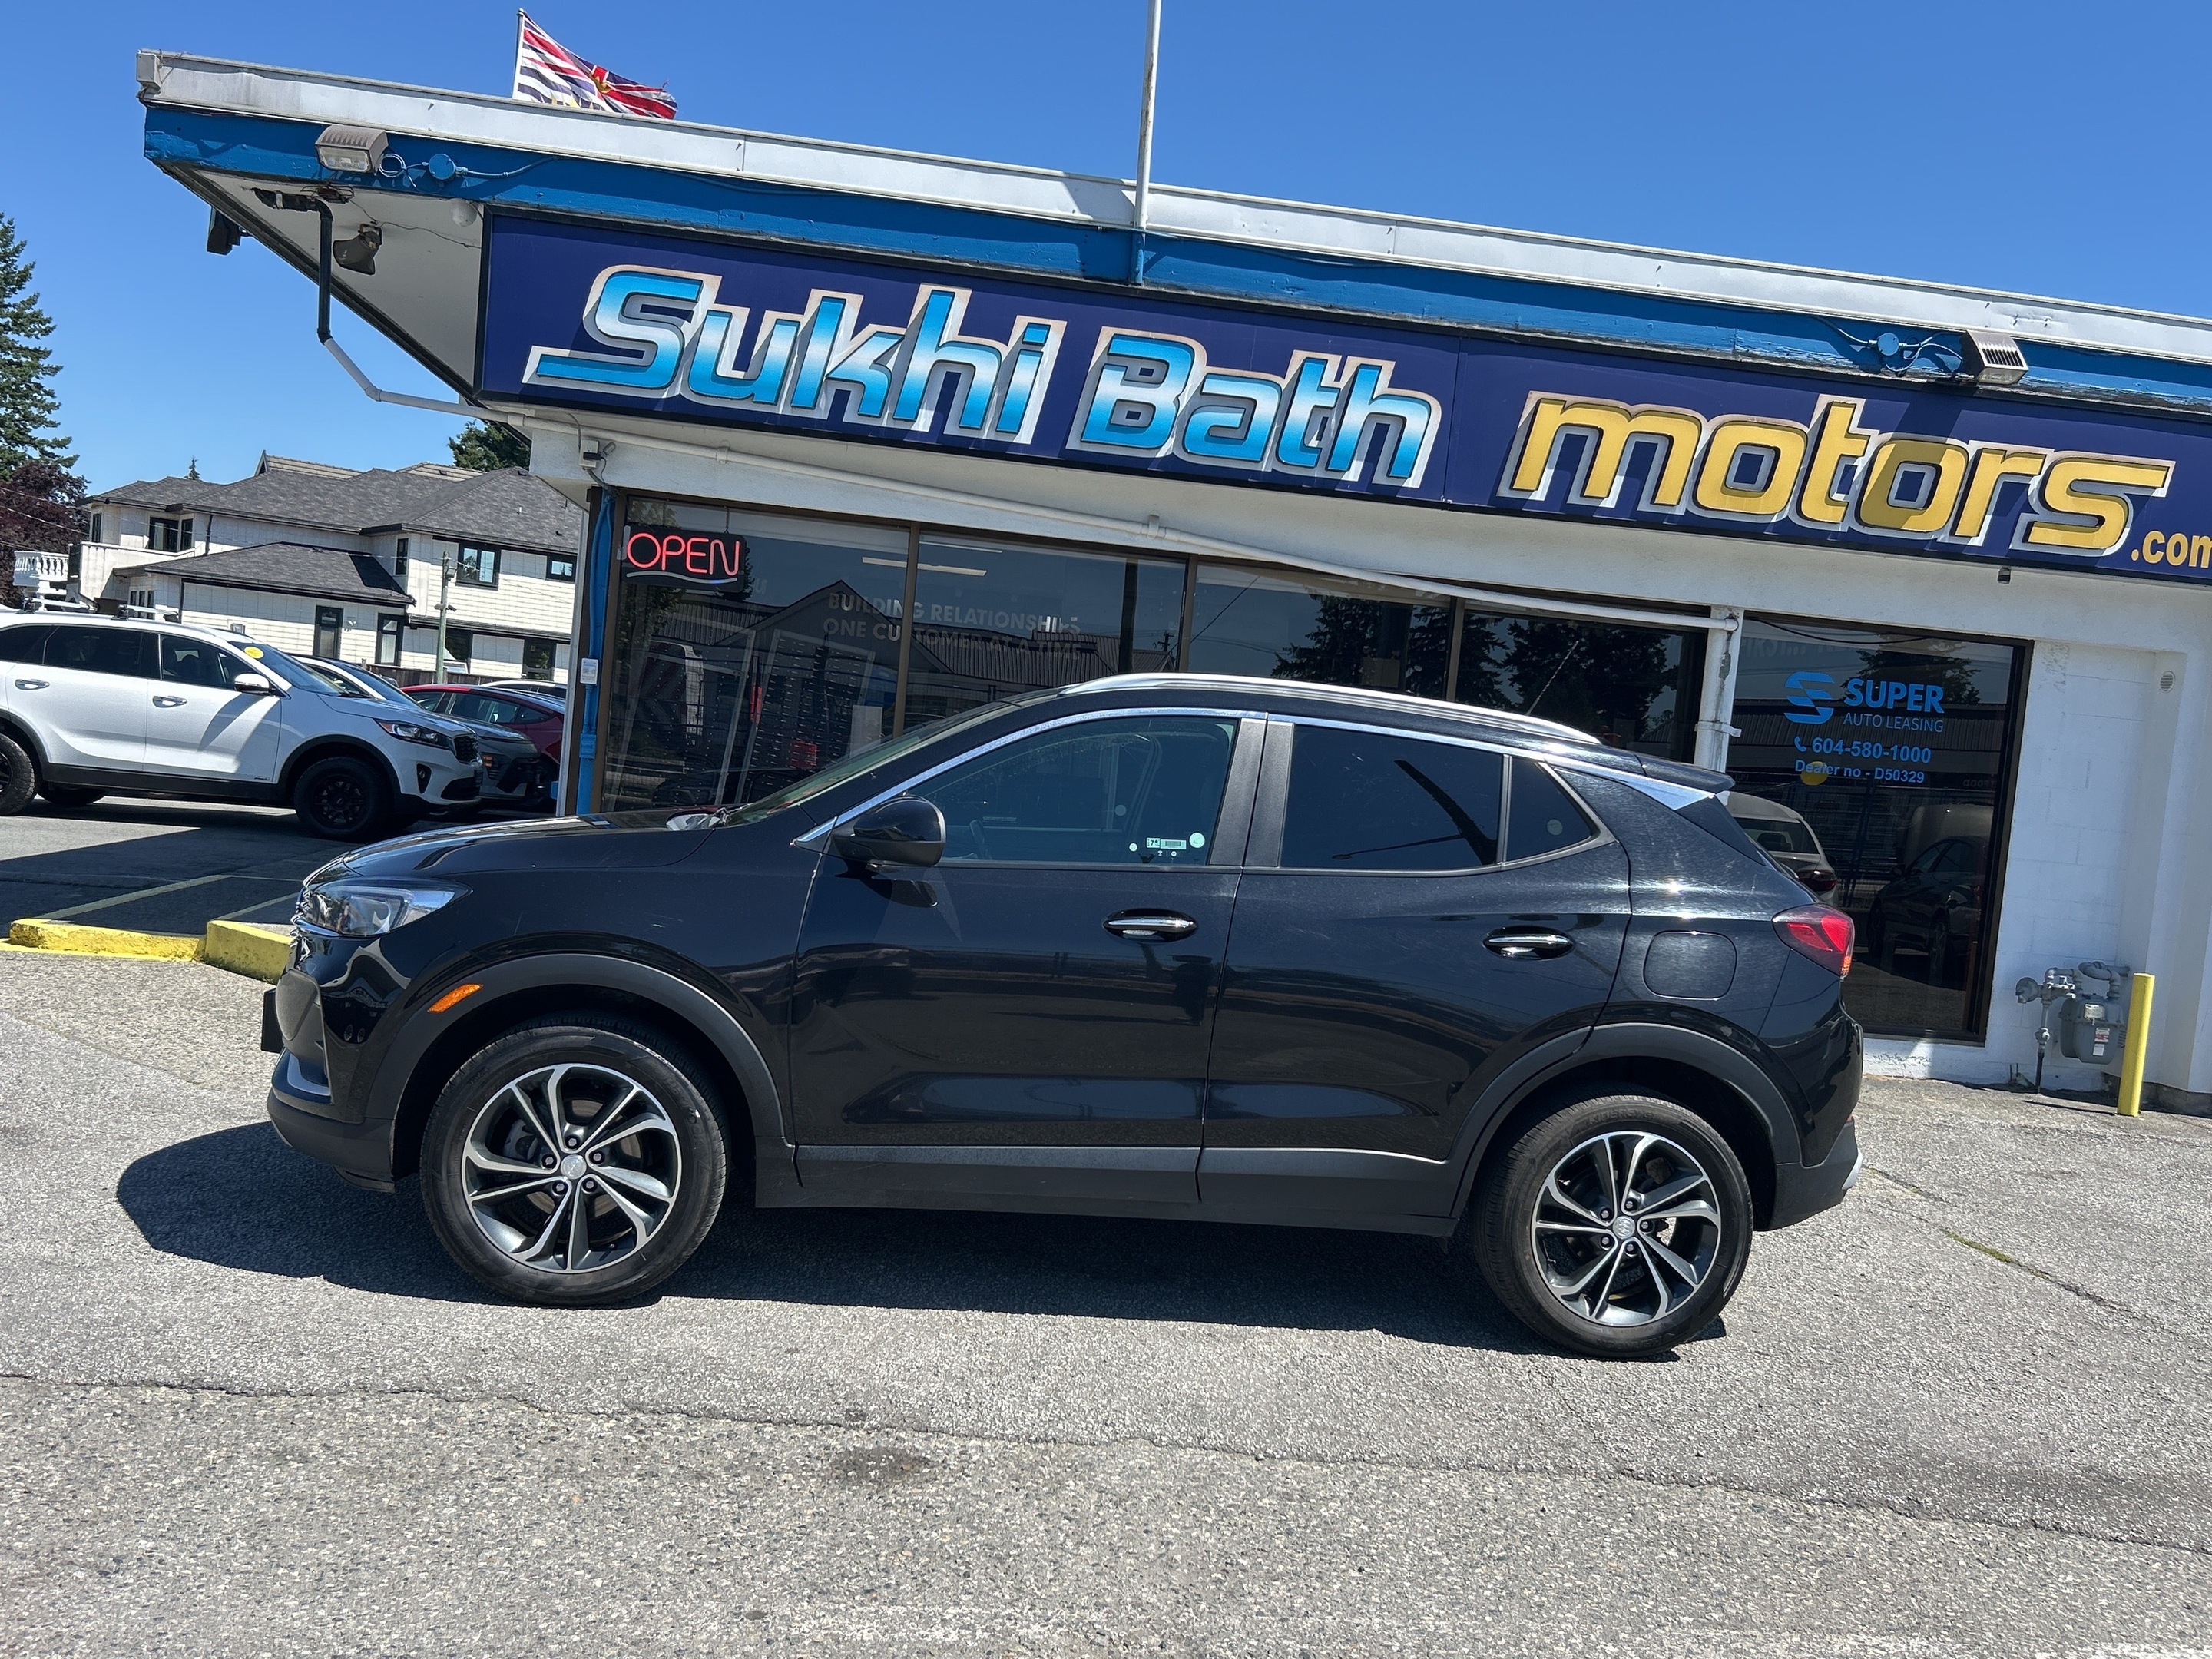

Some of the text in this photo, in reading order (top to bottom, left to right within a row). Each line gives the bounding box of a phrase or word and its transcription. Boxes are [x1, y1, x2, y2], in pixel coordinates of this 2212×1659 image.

[522, 264, 1067, 445] Sukhi
[1066, 326, 1442, 488] Bath
[1495, 390, 2176, 557] motors
[625, 531, 740, 577] OPEN
[823, 618, 867, 638] ONE
[1844, 677, 1945, 714] SUPER
[1843, 712, 1944, 733] AUTO LEASING
[1811, 737, 1932, 763] 604-580-1000
[1795, 759, 1840, 776] Dealer
[1843, 767, 1862, 777] no
[1874, 767, 1925, 783] D50329
